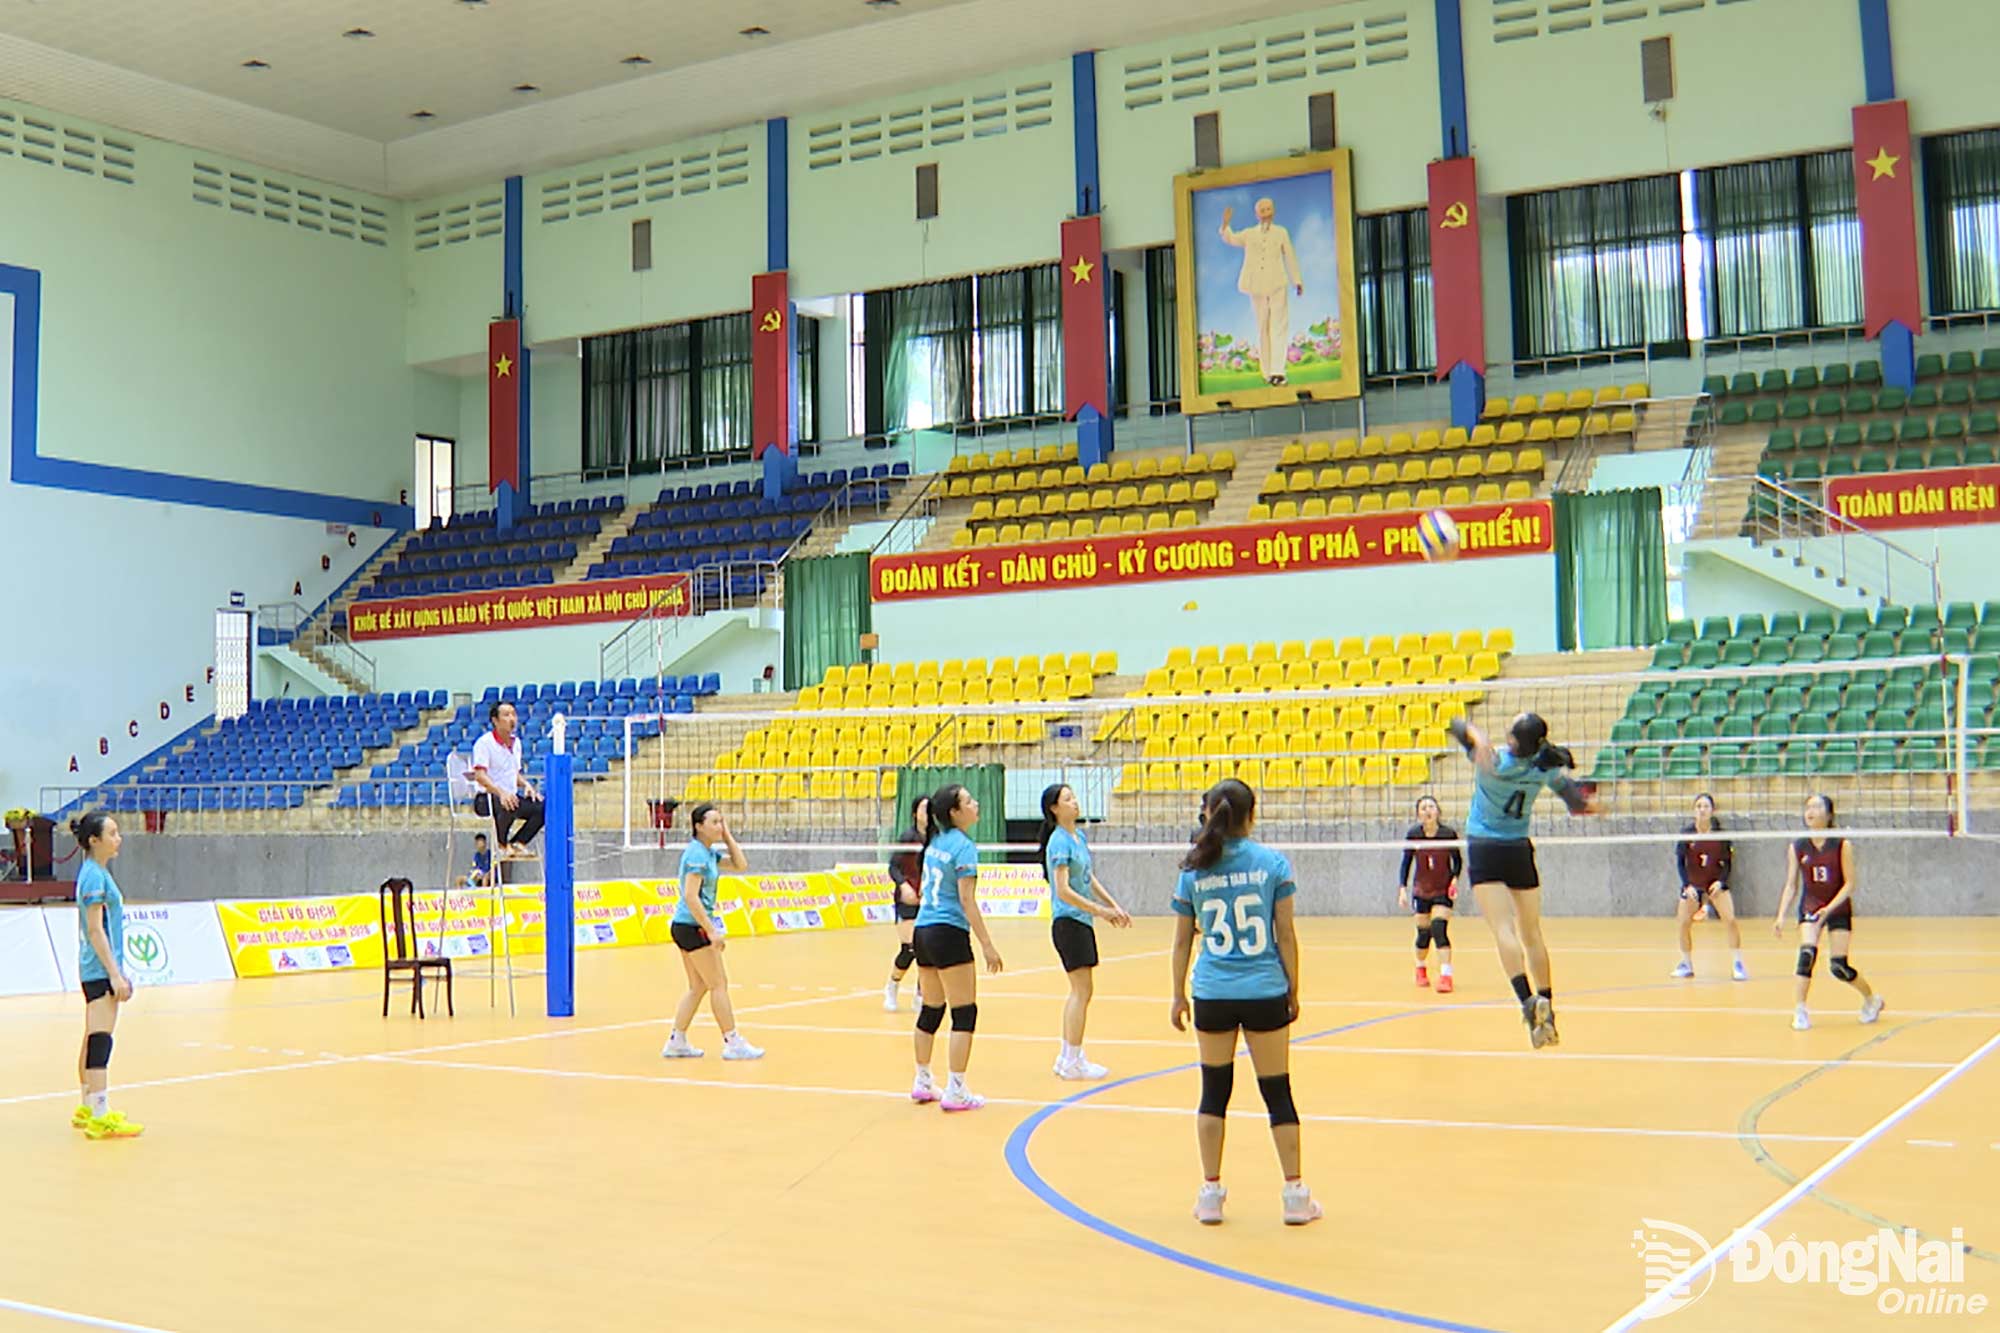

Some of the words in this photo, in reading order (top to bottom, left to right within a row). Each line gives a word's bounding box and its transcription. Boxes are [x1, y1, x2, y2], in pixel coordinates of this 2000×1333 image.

[1836, 488, 1893, 519] TOÀN
[1898, 484, 1944, 514] DÂN
[1950, 480, 1995, 511] RÈN
[880, 562, 937, 594] ĐOÀN
[942, 554, 981, 588] KẾT
[1001, 553, 1046, 585] DÂN
[1052, 543, 1097, 580] CHỦ
[1118, 539, 1148, 576] KỶ
[1154, 539, 1234, 573] CƯƠNG
[1256, 530, 1303, 569] ĐỘT
[1309, 525, 1360, 561] PHÁ
[1383, 527, 1425, 556] PH
[1456, 507, 1541, 550] TRIỂN!
[293, 580, 302, 596] A
[442, 604, 455, 625] VÀ
[507, 596, 533, 620] QUỐC
[536, 596, 557, 619] VIỆT
[560, 595, 585, 615] NAM
[604, 589, 622, 615] HỘI
[625, 584, 647, 610] CHỦ
[206, 666, 214, 684] F
[186, 684, 195, 702] E
[160, 702, 170, 720] D
[129, 720, 138, 737] C
[99, 737, 108, 755] B
[69, 755, 79, 772] A
[1504, 790, 1525, 819] 4
[1812, 866, 1828, 882] 13
[1201, 893, 1267, 955] 35
